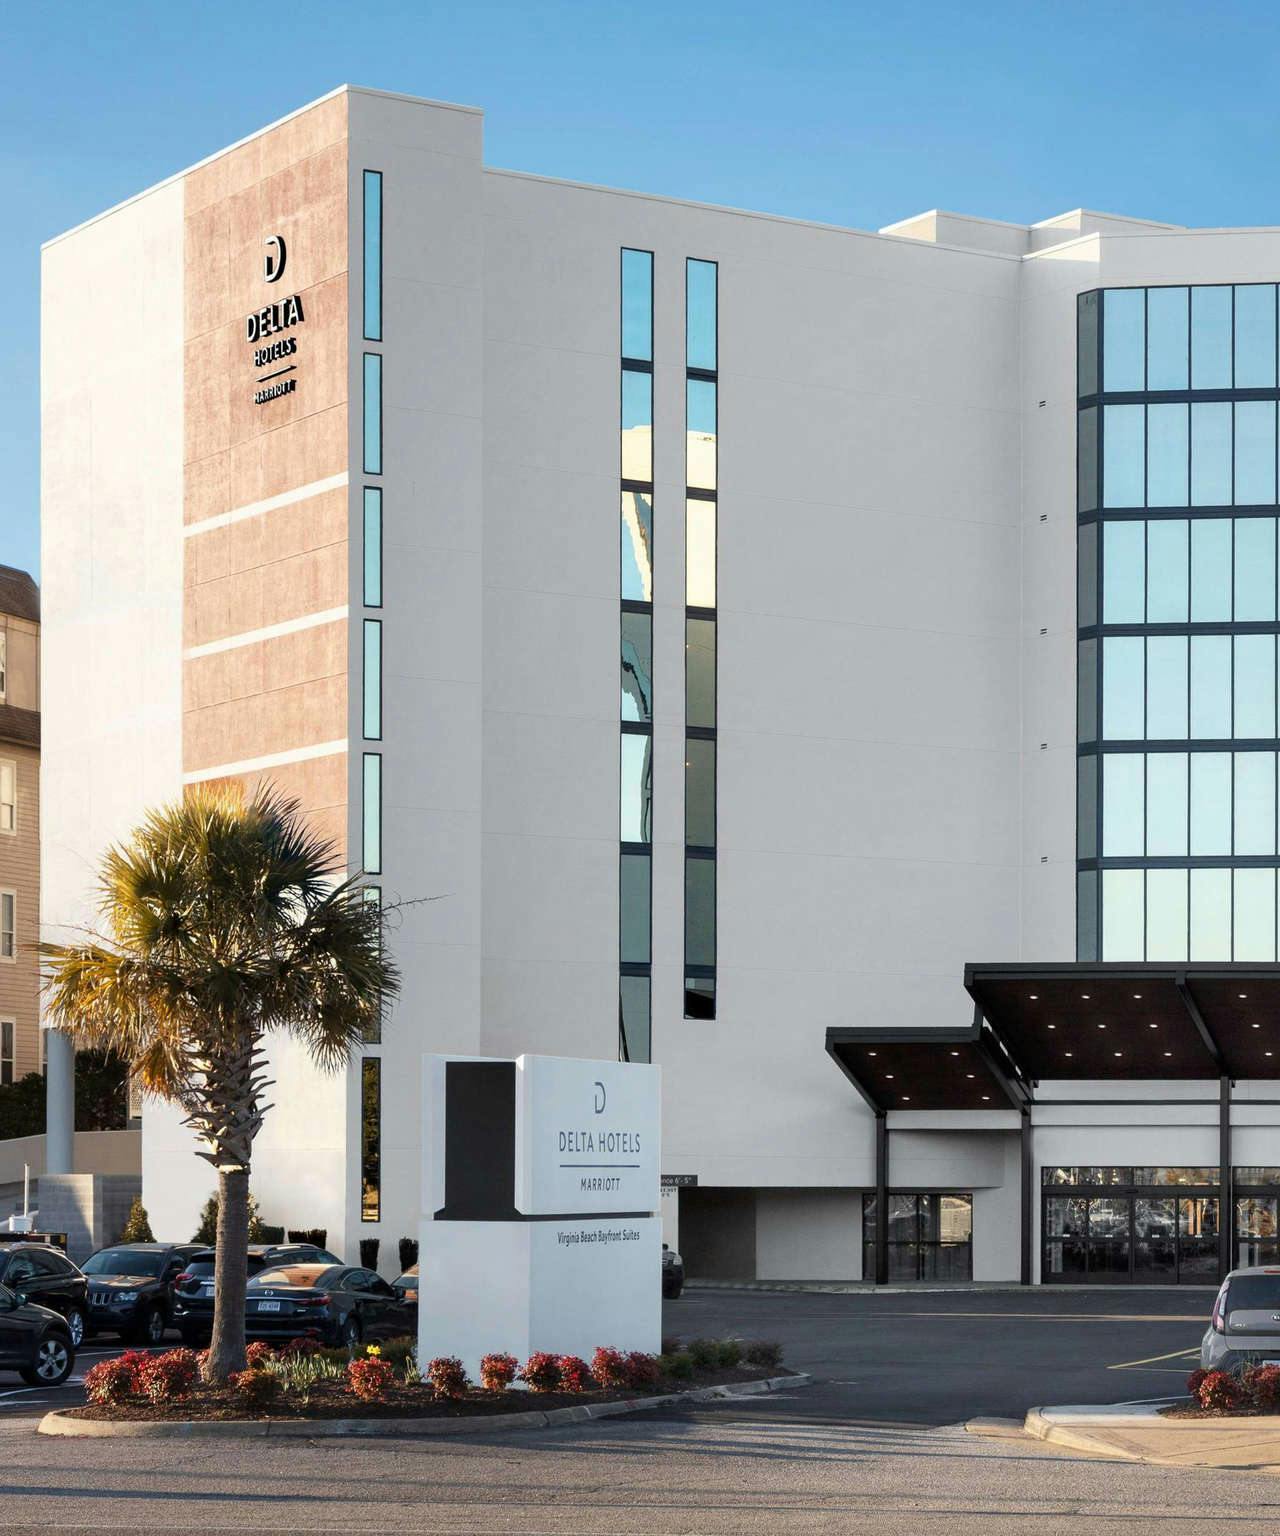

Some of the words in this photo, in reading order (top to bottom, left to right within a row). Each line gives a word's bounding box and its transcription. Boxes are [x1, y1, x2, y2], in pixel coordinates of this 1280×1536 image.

[246, 295, 304, 342] DELTA
[254, 337, 297, 367] HOTELS
[253, 379, 297, 405] MARRIOTT
[559, 1131, 595, 1152] DELTA
[598, 1132, 641, 1153] HOTELS
[580, 1177, 621, 1192] MARRIOTT
[557, 1231, 580, 1247] Virginia
[580, 1230, 597, 1243] Beach
[598, 1229, 621, 1245] Bayfront
[622, 1229, 640, 1241] Suites
